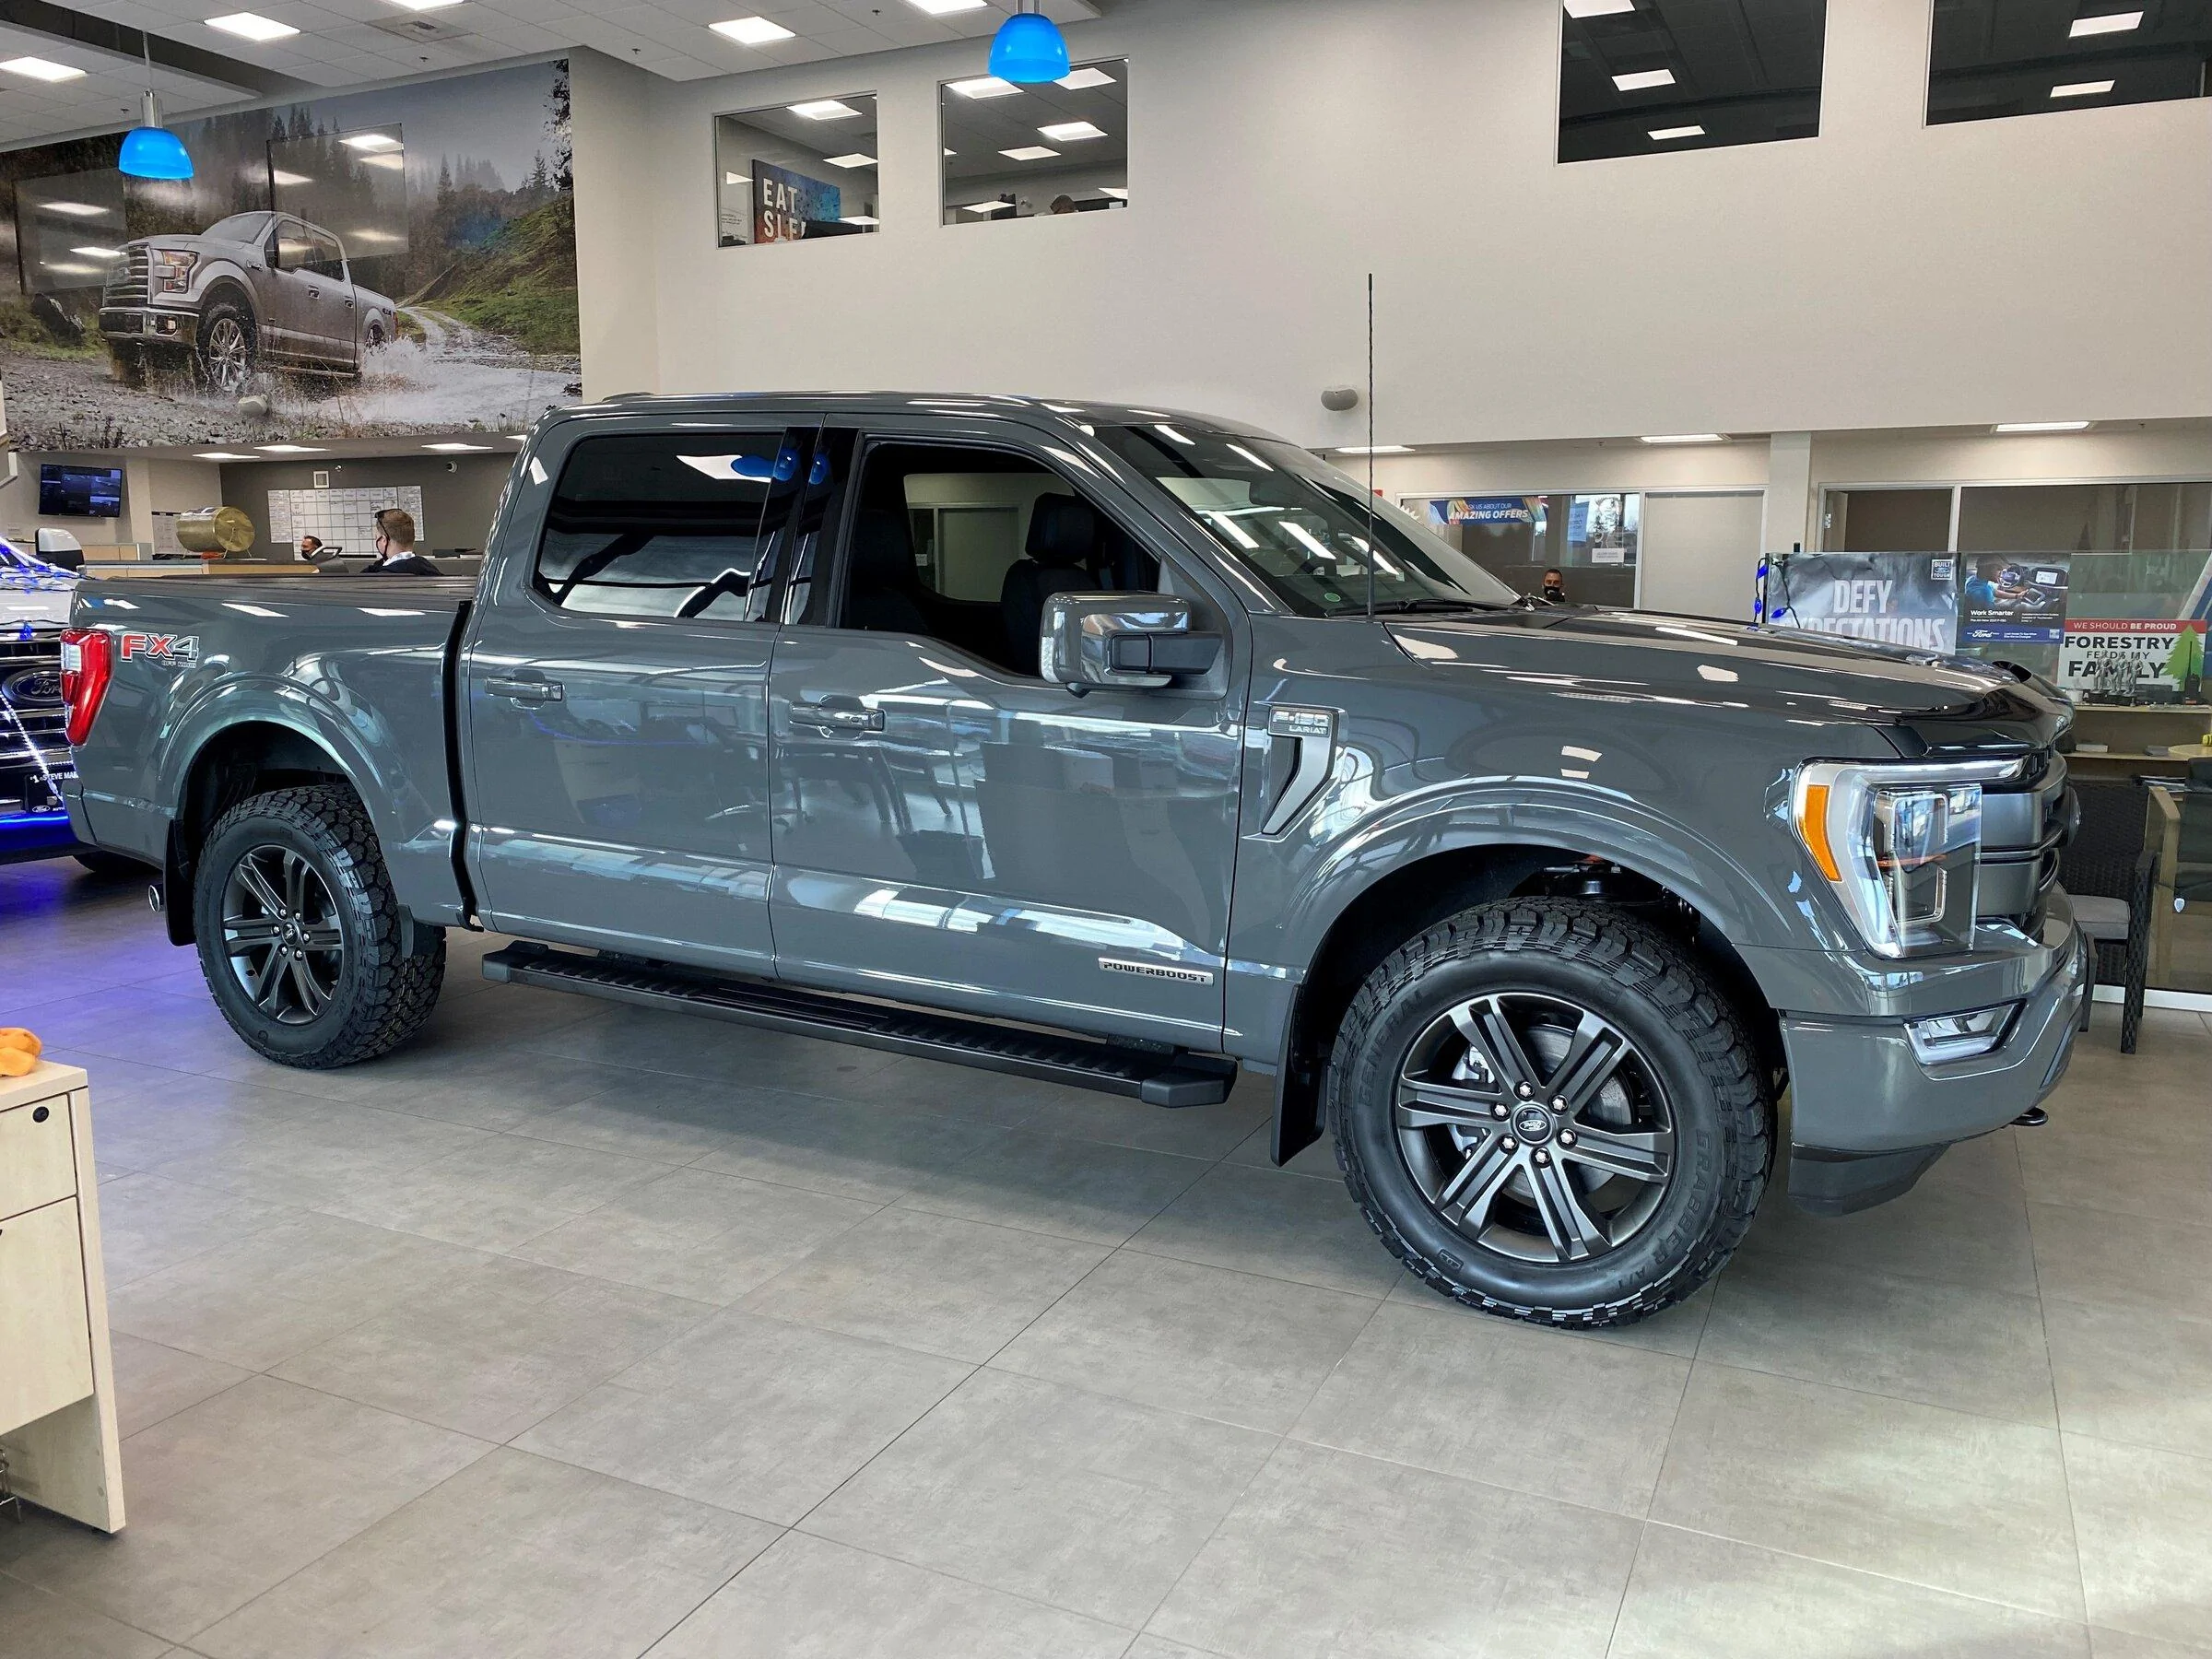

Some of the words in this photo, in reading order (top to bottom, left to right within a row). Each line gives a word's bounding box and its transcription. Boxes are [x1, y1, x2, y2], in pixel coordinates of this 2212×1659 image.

[763, 178, 798, 214] EAT
[1450, 511, 1491, 521] AMAZING
[1492, 509, 1529, 519] OFFERS
[1832, 580, 1893, 614] DEFY
[1783, 618, 1946, 651] CTATIONS
[1971, 629, 1993, 638] Ford
[121, 633, 199, 663] FX4
[2065, 636, 2175, 650] FORESTRY
[2087, 651, 2126, 660] FED
[2067, 660, 2166, 679] FALY
[30, 677, 63, 695] For
[1288, 724, 1327, 735] LARIAT
[42, 772, 63, 781] STEVE
[1103, 961, 1207, 983] POWERBOOST
[1653, 1128, 1712, 1265] GRABBER
